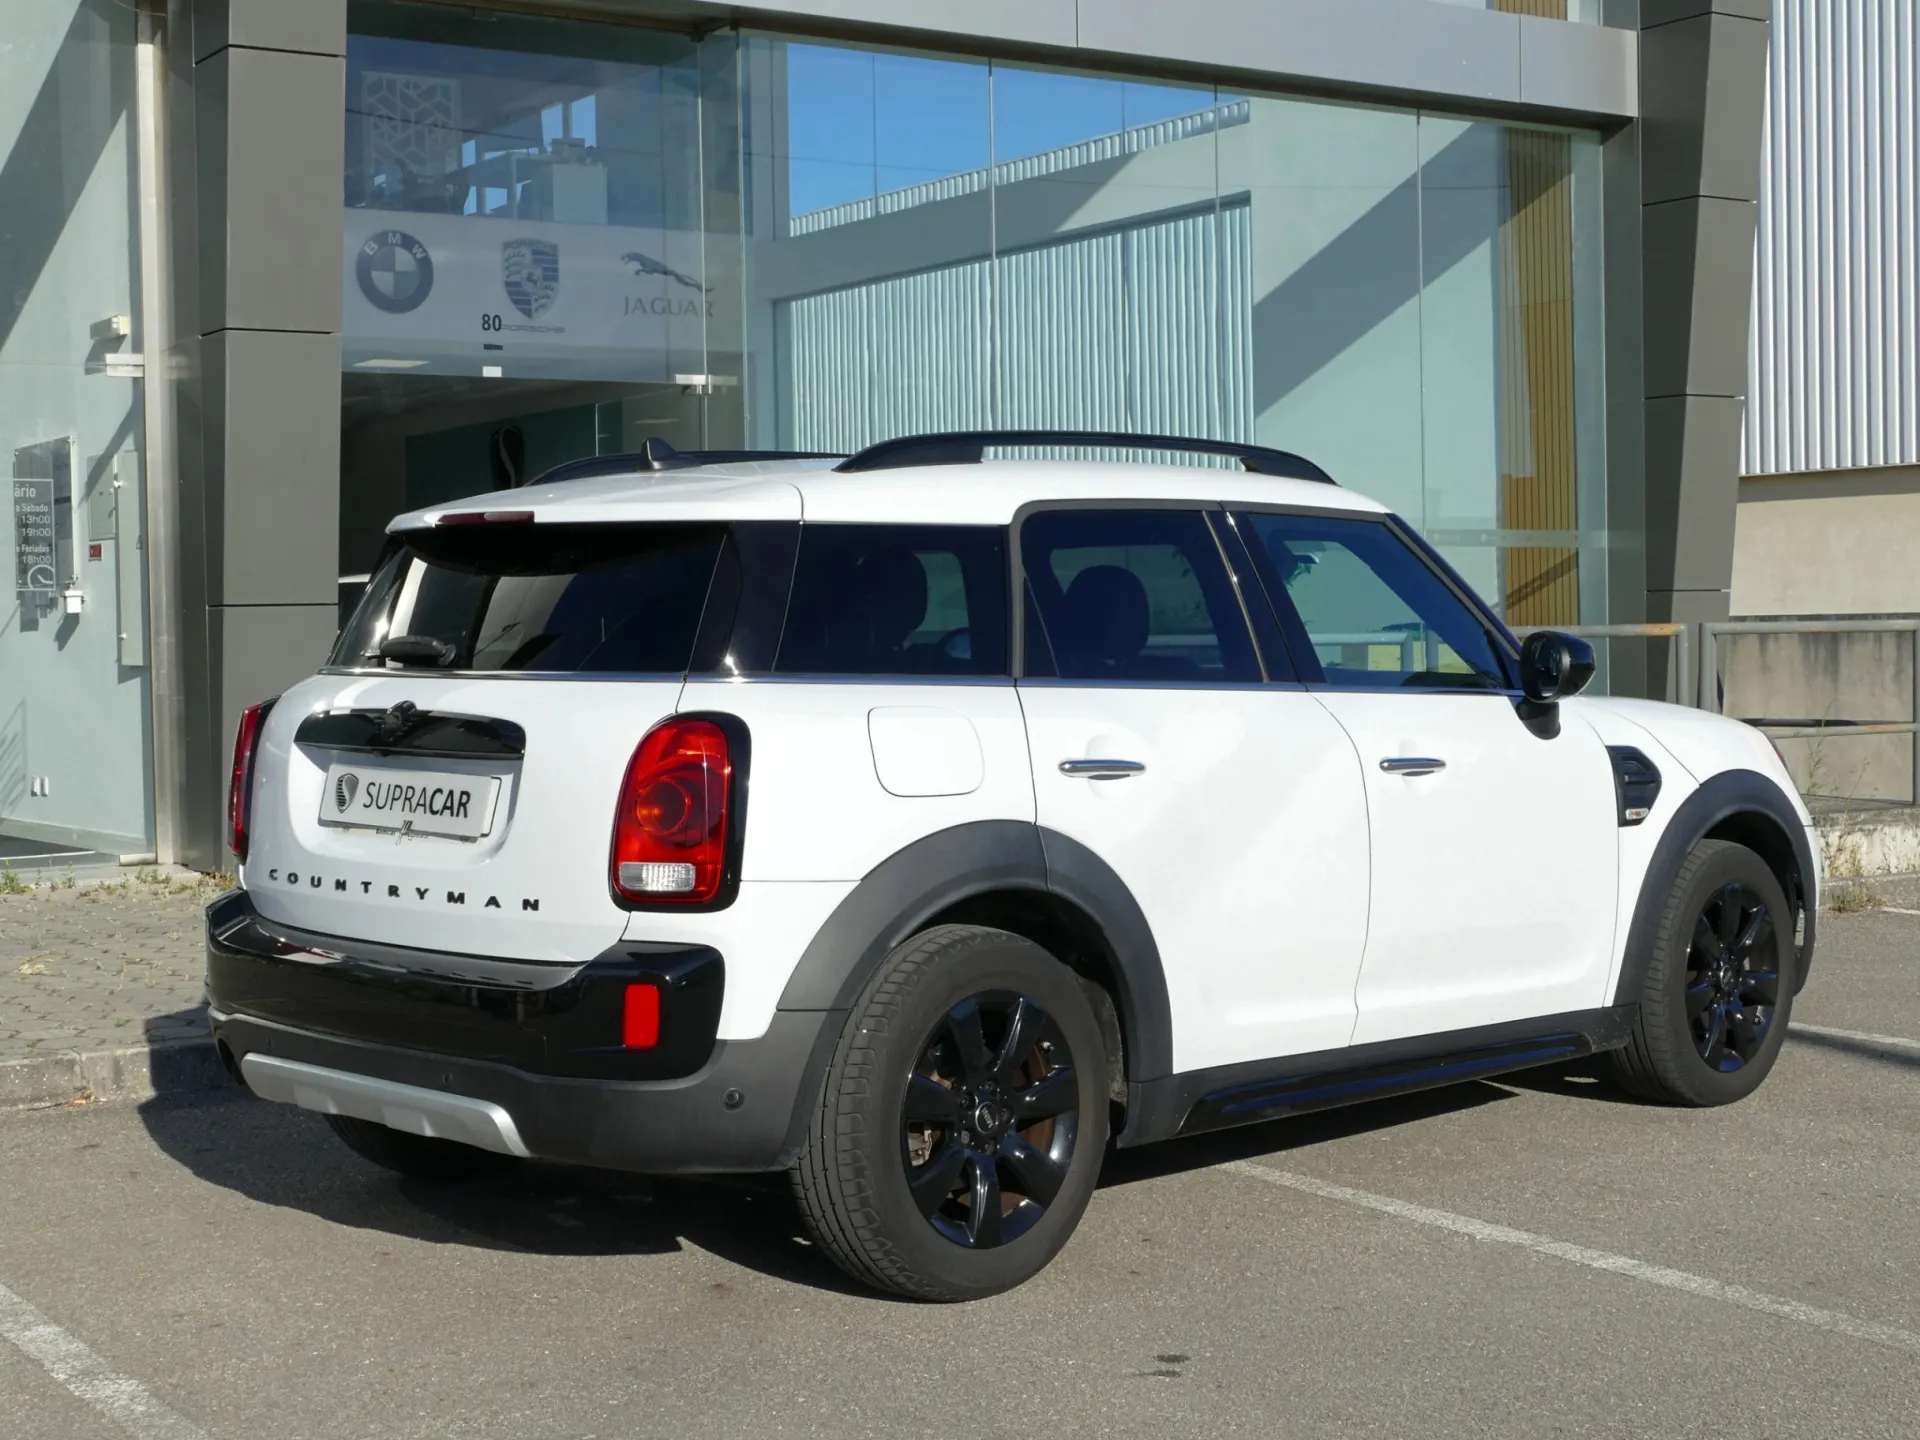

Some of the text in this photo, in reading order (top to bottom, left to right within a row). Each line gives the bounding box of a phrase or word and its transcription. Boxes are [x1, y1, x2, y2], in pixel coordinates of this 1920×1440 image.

[364, 232, 426, 259] BMW
[624, 296, 713, 317] JAGUAR
[482, 313, 502, 332] 80
[14, 484, 36, 498] ário
[22, 515, 51, 524] 13h00
[22, 528, 51, 537] 19h00
[22, 555, 51, 564] 18h00
[362, 781, 471, 818] SUPRACAR
[268, 868, 540, 912] COUNTRYMAN
